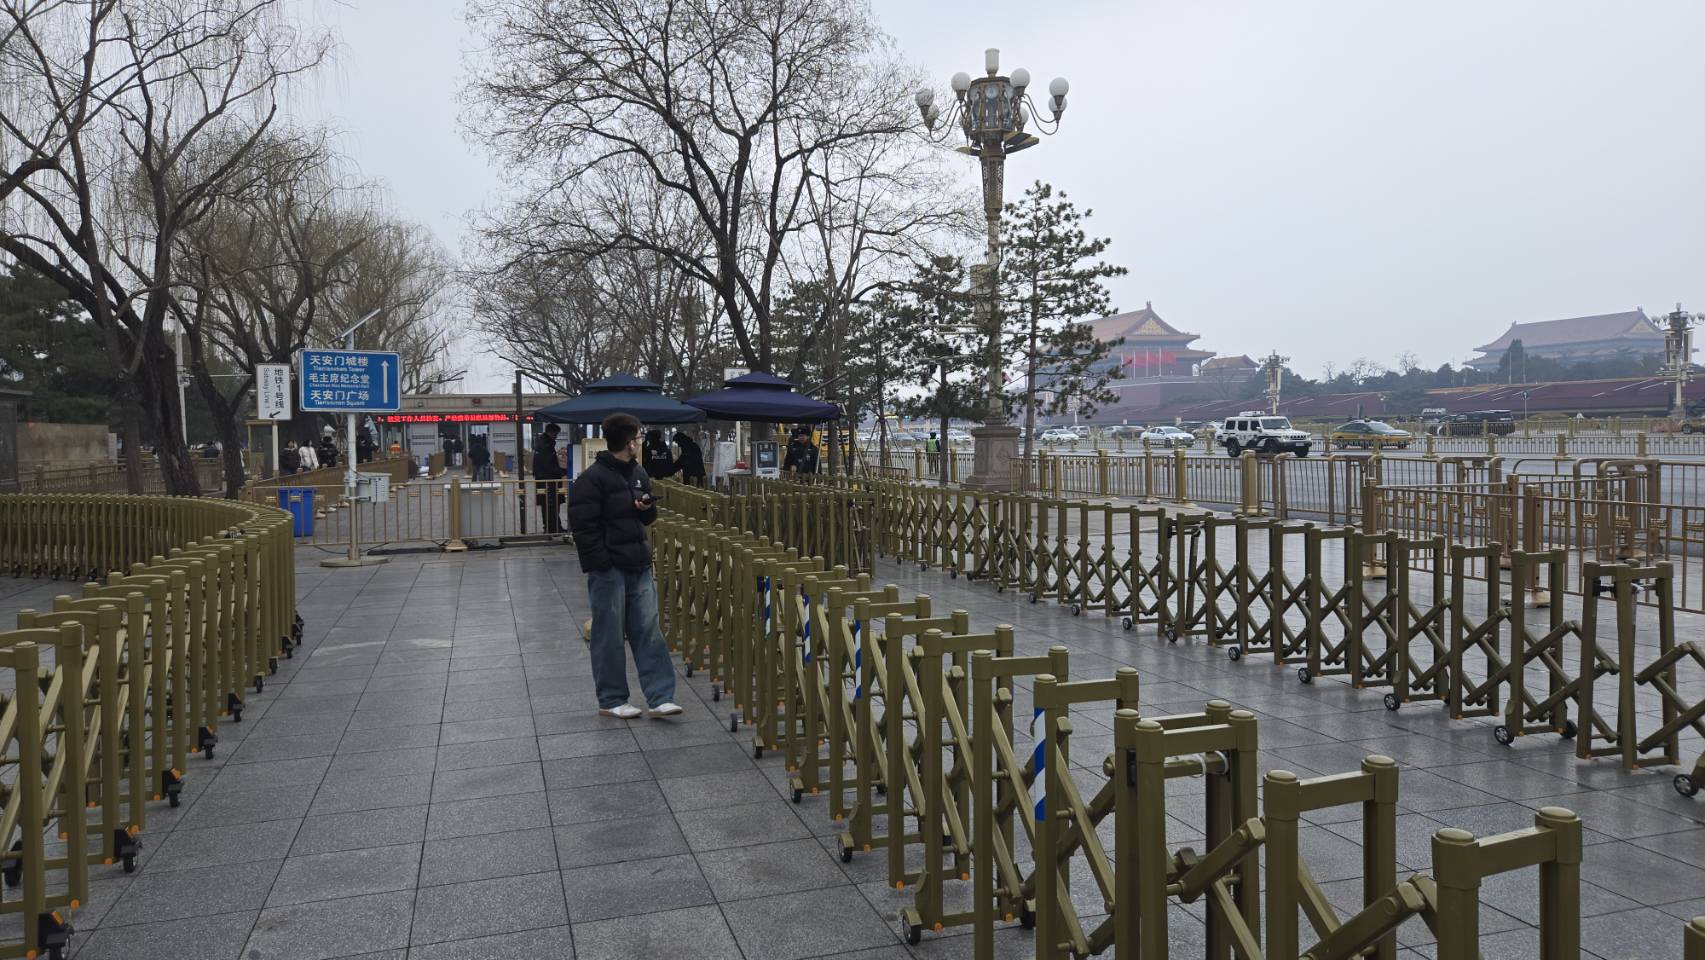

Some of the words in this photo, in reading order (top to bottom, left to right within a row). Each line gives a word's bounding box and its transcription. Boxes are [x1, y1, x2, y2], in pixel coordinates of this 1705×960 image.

[310, 355, 369, 366] 天安门城楼
[308, 373, 370, 384] 毛主席纪念堂
[274, 367, 285, 408] 地铁1号线
[310, 390, 369, 401] 天安门广场
